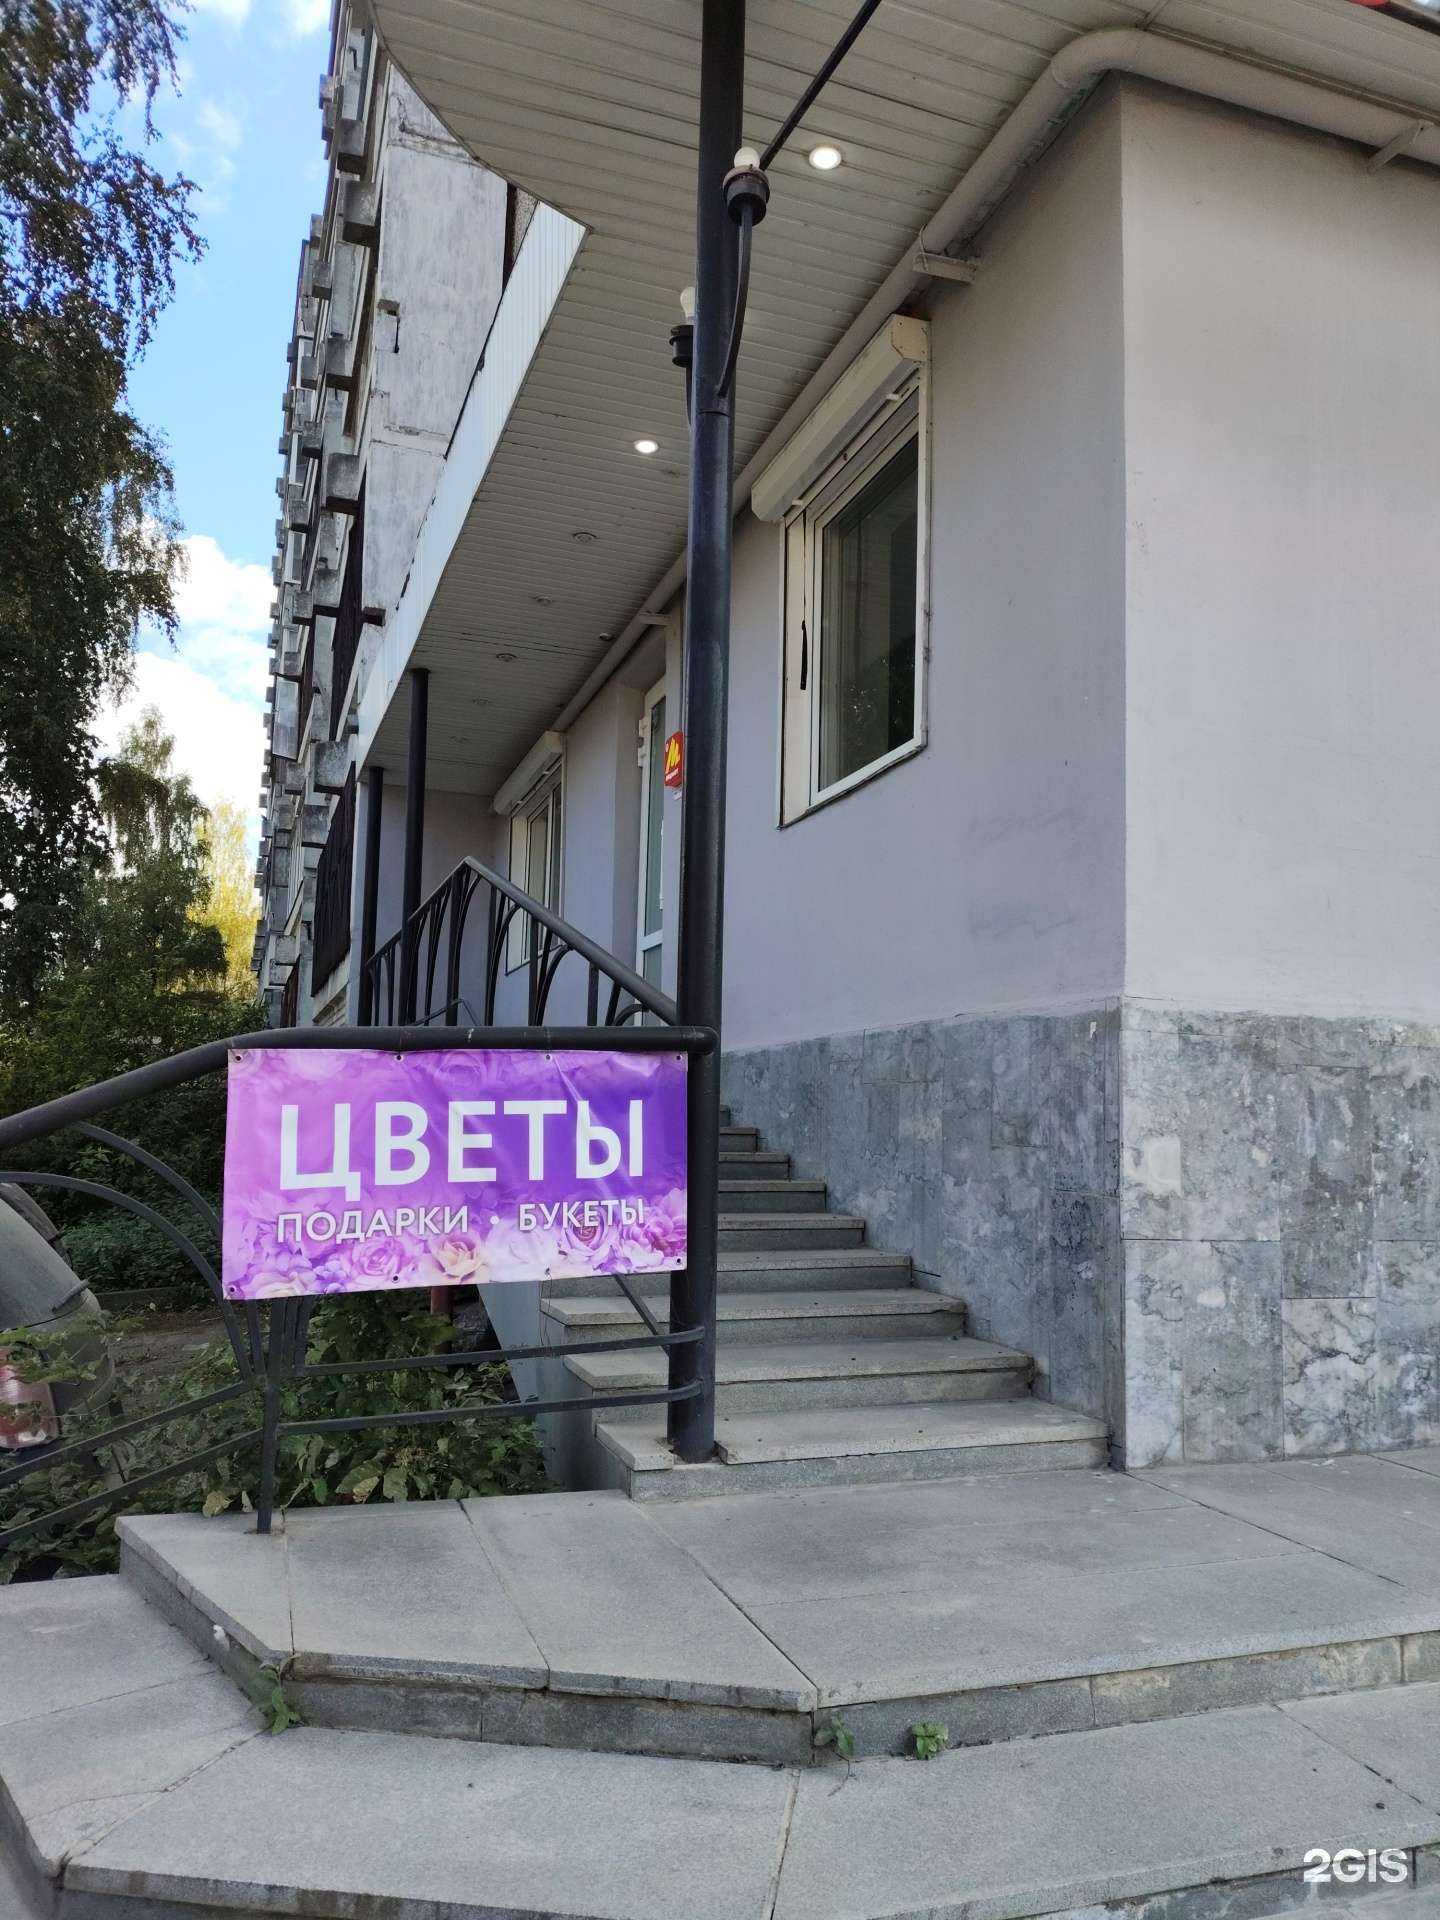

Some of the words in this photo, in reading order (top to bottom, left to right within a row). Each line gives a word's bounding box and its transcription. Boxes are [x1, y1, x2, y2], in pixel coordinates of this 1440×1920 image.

[279, 1099, 644, 1202] ЦВЕТЫ
[276, 1205, 470, 1244] ПОДАРКИ
[518, 1199, 645, 1232] БУКЕТЫ
